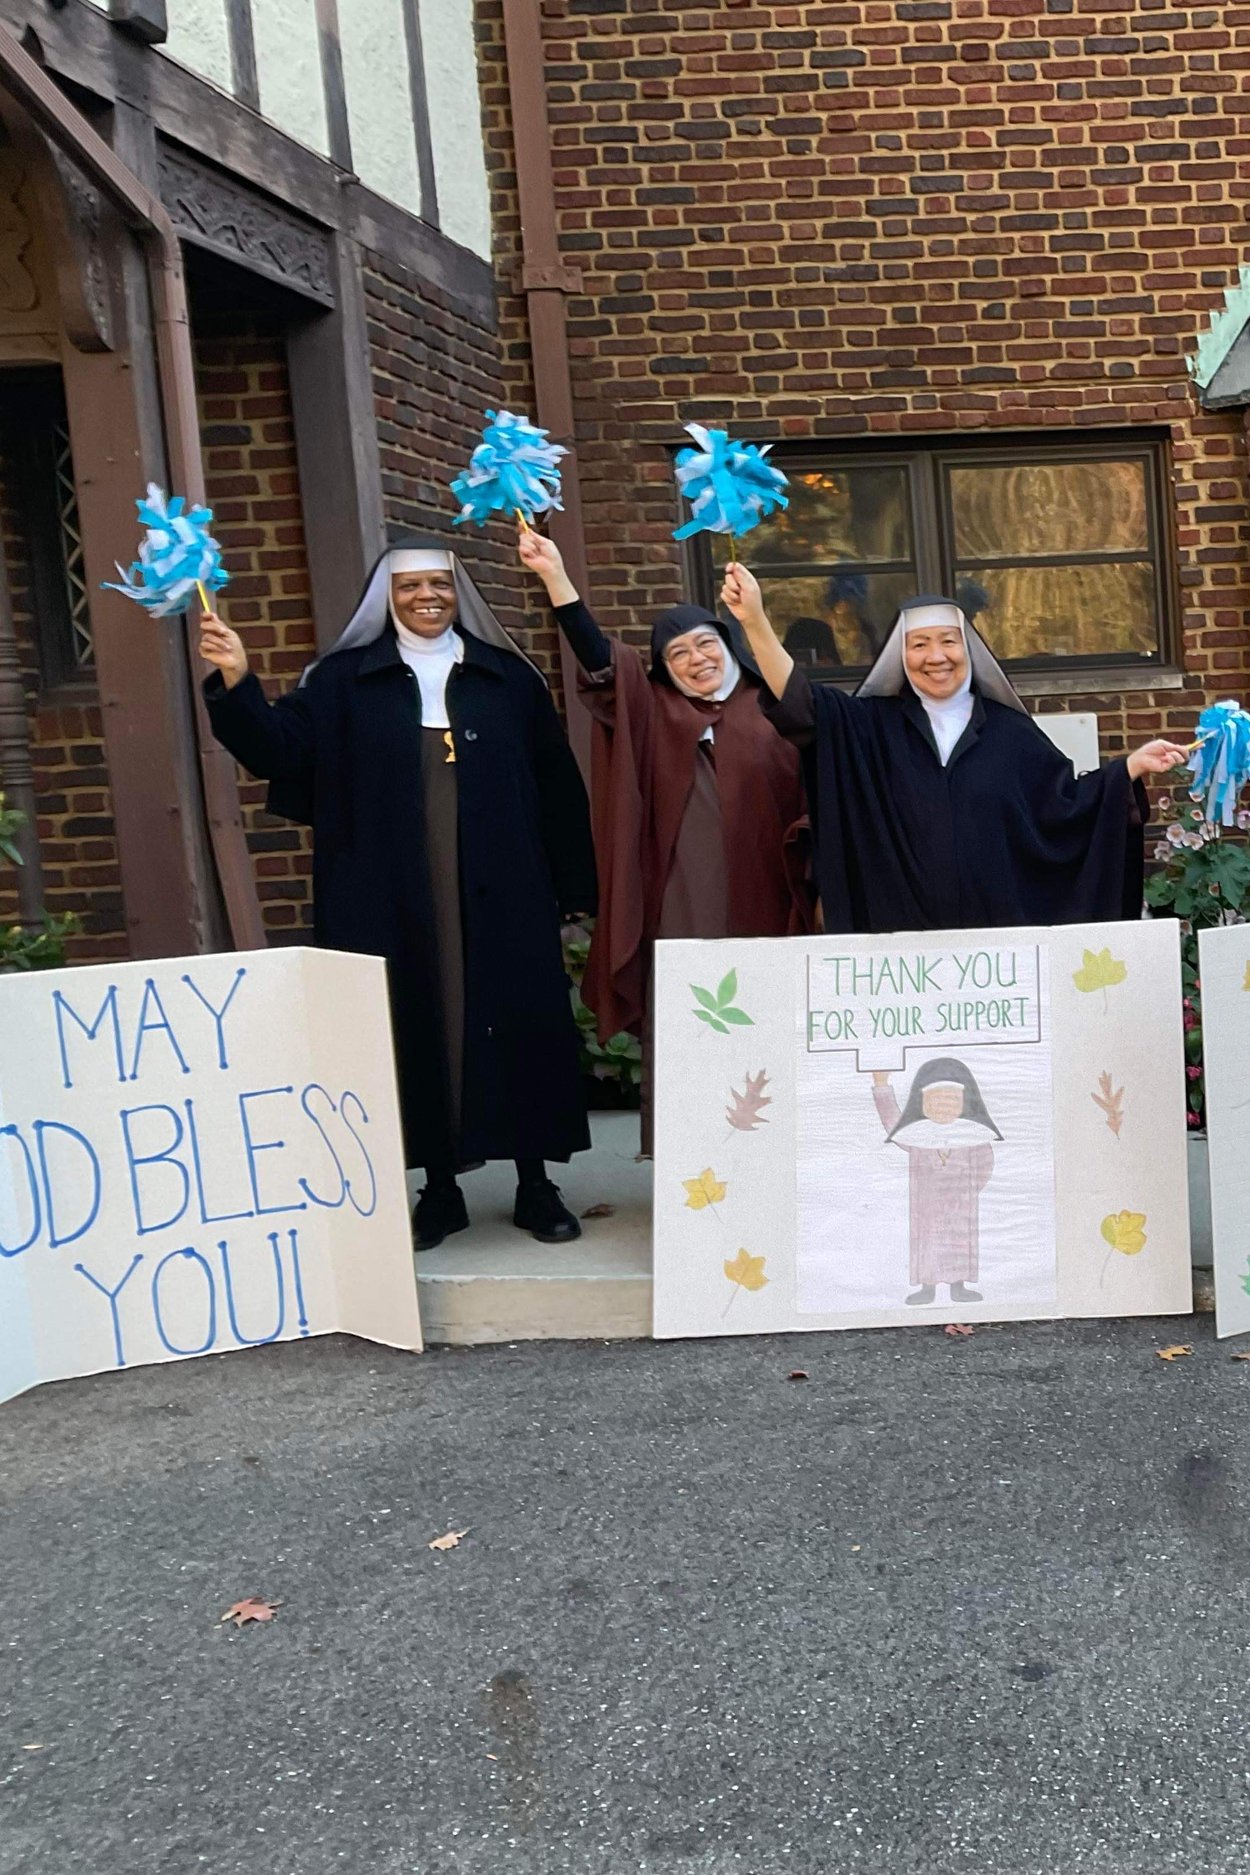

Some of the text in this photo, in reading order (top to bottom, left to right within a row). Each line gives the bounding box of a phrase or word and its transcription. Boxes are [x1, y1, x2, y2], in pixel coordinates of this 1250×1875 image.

[53, 968, 246, 1088] MAY
[809, 997, 1029, 1042] FOR YOUR SUPPORT
[823, 952, 1017, 996] THANK YOU
[0, 1083, 377, 1258] OD BLESS
[74, 1228, 310, 1367] YOU!
